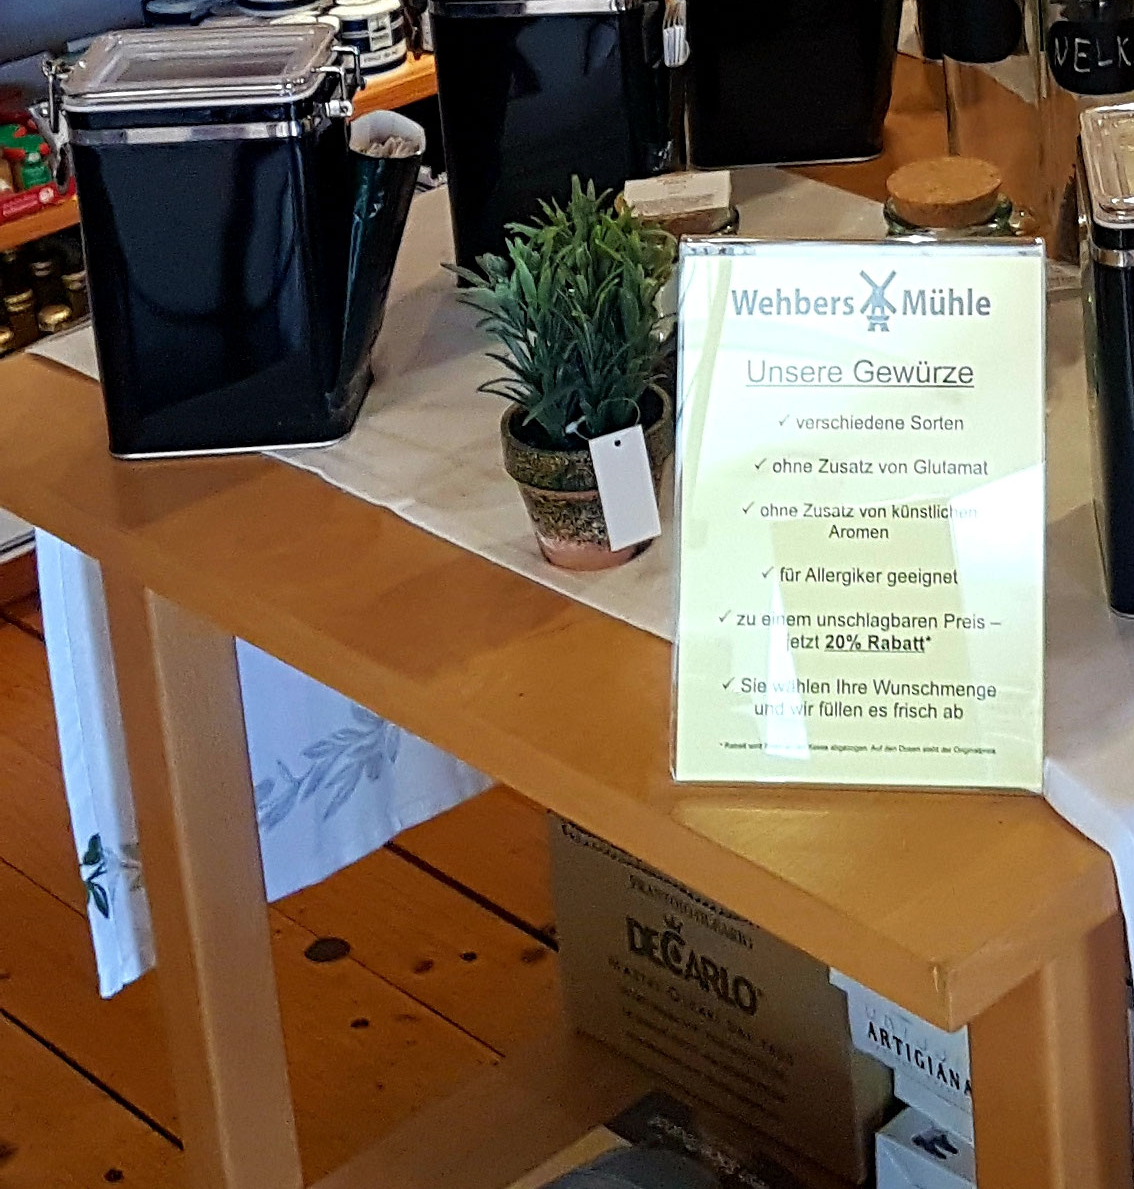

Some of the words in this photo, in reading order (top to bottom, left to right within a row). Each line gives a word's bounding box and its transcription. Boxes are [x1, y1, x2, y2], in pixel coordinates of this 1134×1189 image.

[731, 288, 855, 316] Wehbers
[902, 288, 992, 316] Mühle
[747, 360, 843, 384] Unsere
[853, 359, 975, 385] Gewürze
[796, 414, 905, 431] verschiedene
[910, 415, 965, 431] Sorten
[772, 458, 813, 474] ohne
[818, 458, 874, 475] Zusatz
[878, 461, 908, 474] von
[913, 459, 989, 476] Glutamat
[760, 502, 798, 518] ohne
[803, 502, 855, 519] Zusatz
[859, 507, 887, 519] von
[828, 524, 890, 540] Aromen
[779, 567, 801, 583] für
[805, 567, 883, 587] Allergiker
[887, 568, 959, 588] geeignet
[736, 614, 756, 627] zu
[761, 613, 811, 627] einem
[816, 613, 938, 632] unschlagbaren
[943, 613, 986, 630] Preis
[824, 635, 862, 651] 20%
[740, 677, 767, 694] Sie
[836, 678, 868, 695] Ihre
[872, 678, 997, 700] Wunschmenge
[819, 701, 863, 718] füllen
[868, 704, 888, 718] es
[893, 702, 938, 719] frisch
[943, 703, 964, 720] ab
